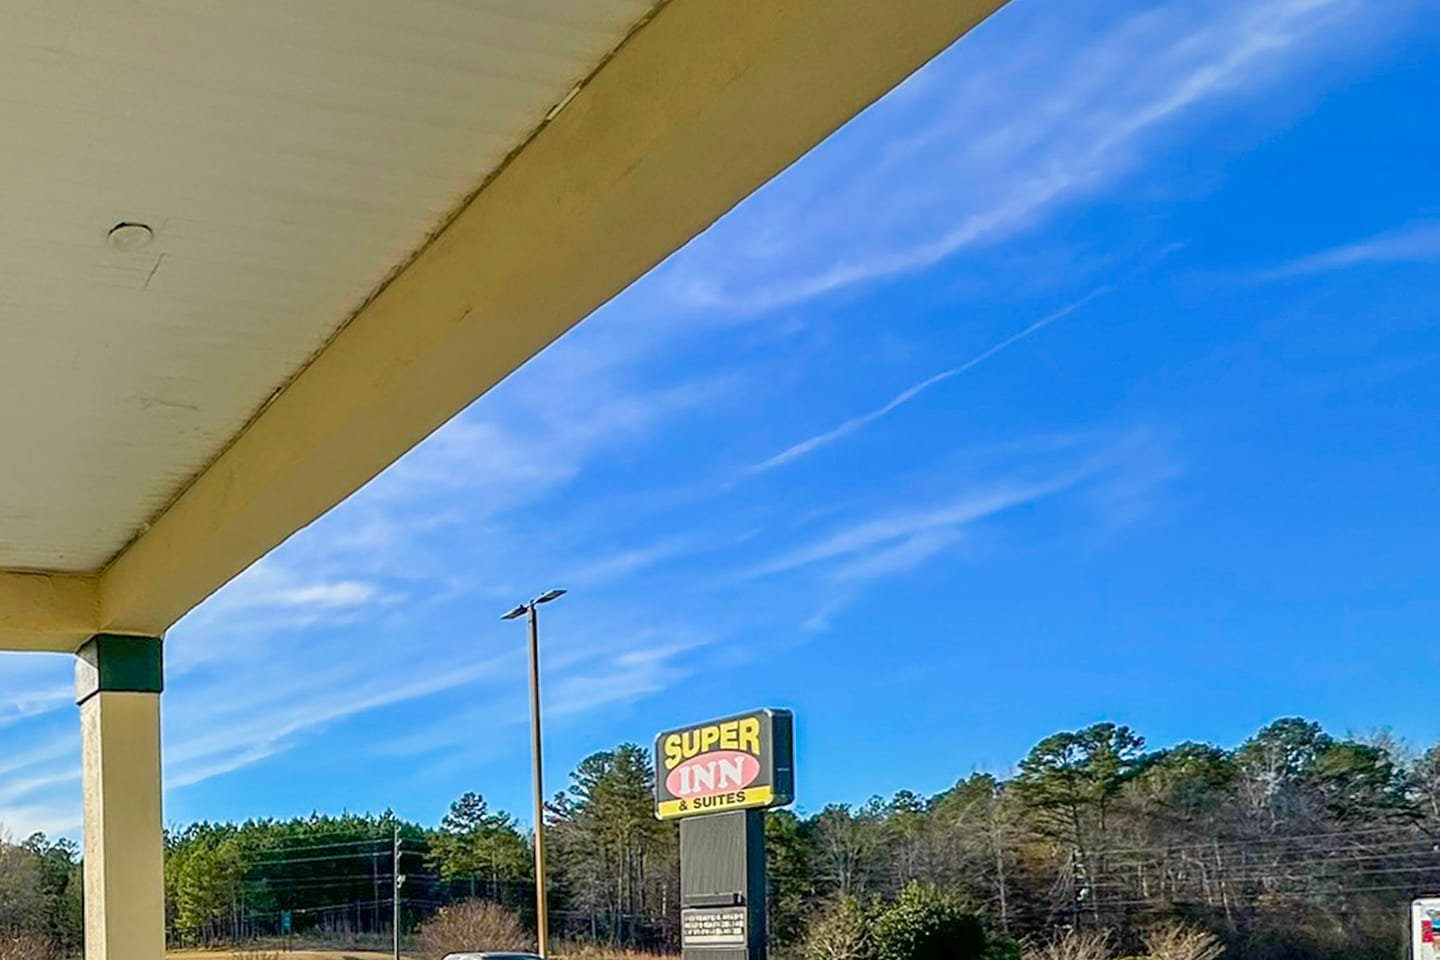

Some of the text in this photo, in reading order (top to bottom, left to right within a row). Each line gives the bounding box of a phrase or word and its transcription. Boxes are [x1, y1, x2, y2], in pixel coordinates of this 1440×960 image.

[664, 717, 760, 770] SUPER
[678, 756, 745, 795] INN
[678, 791, 746, 811] & SUITES
